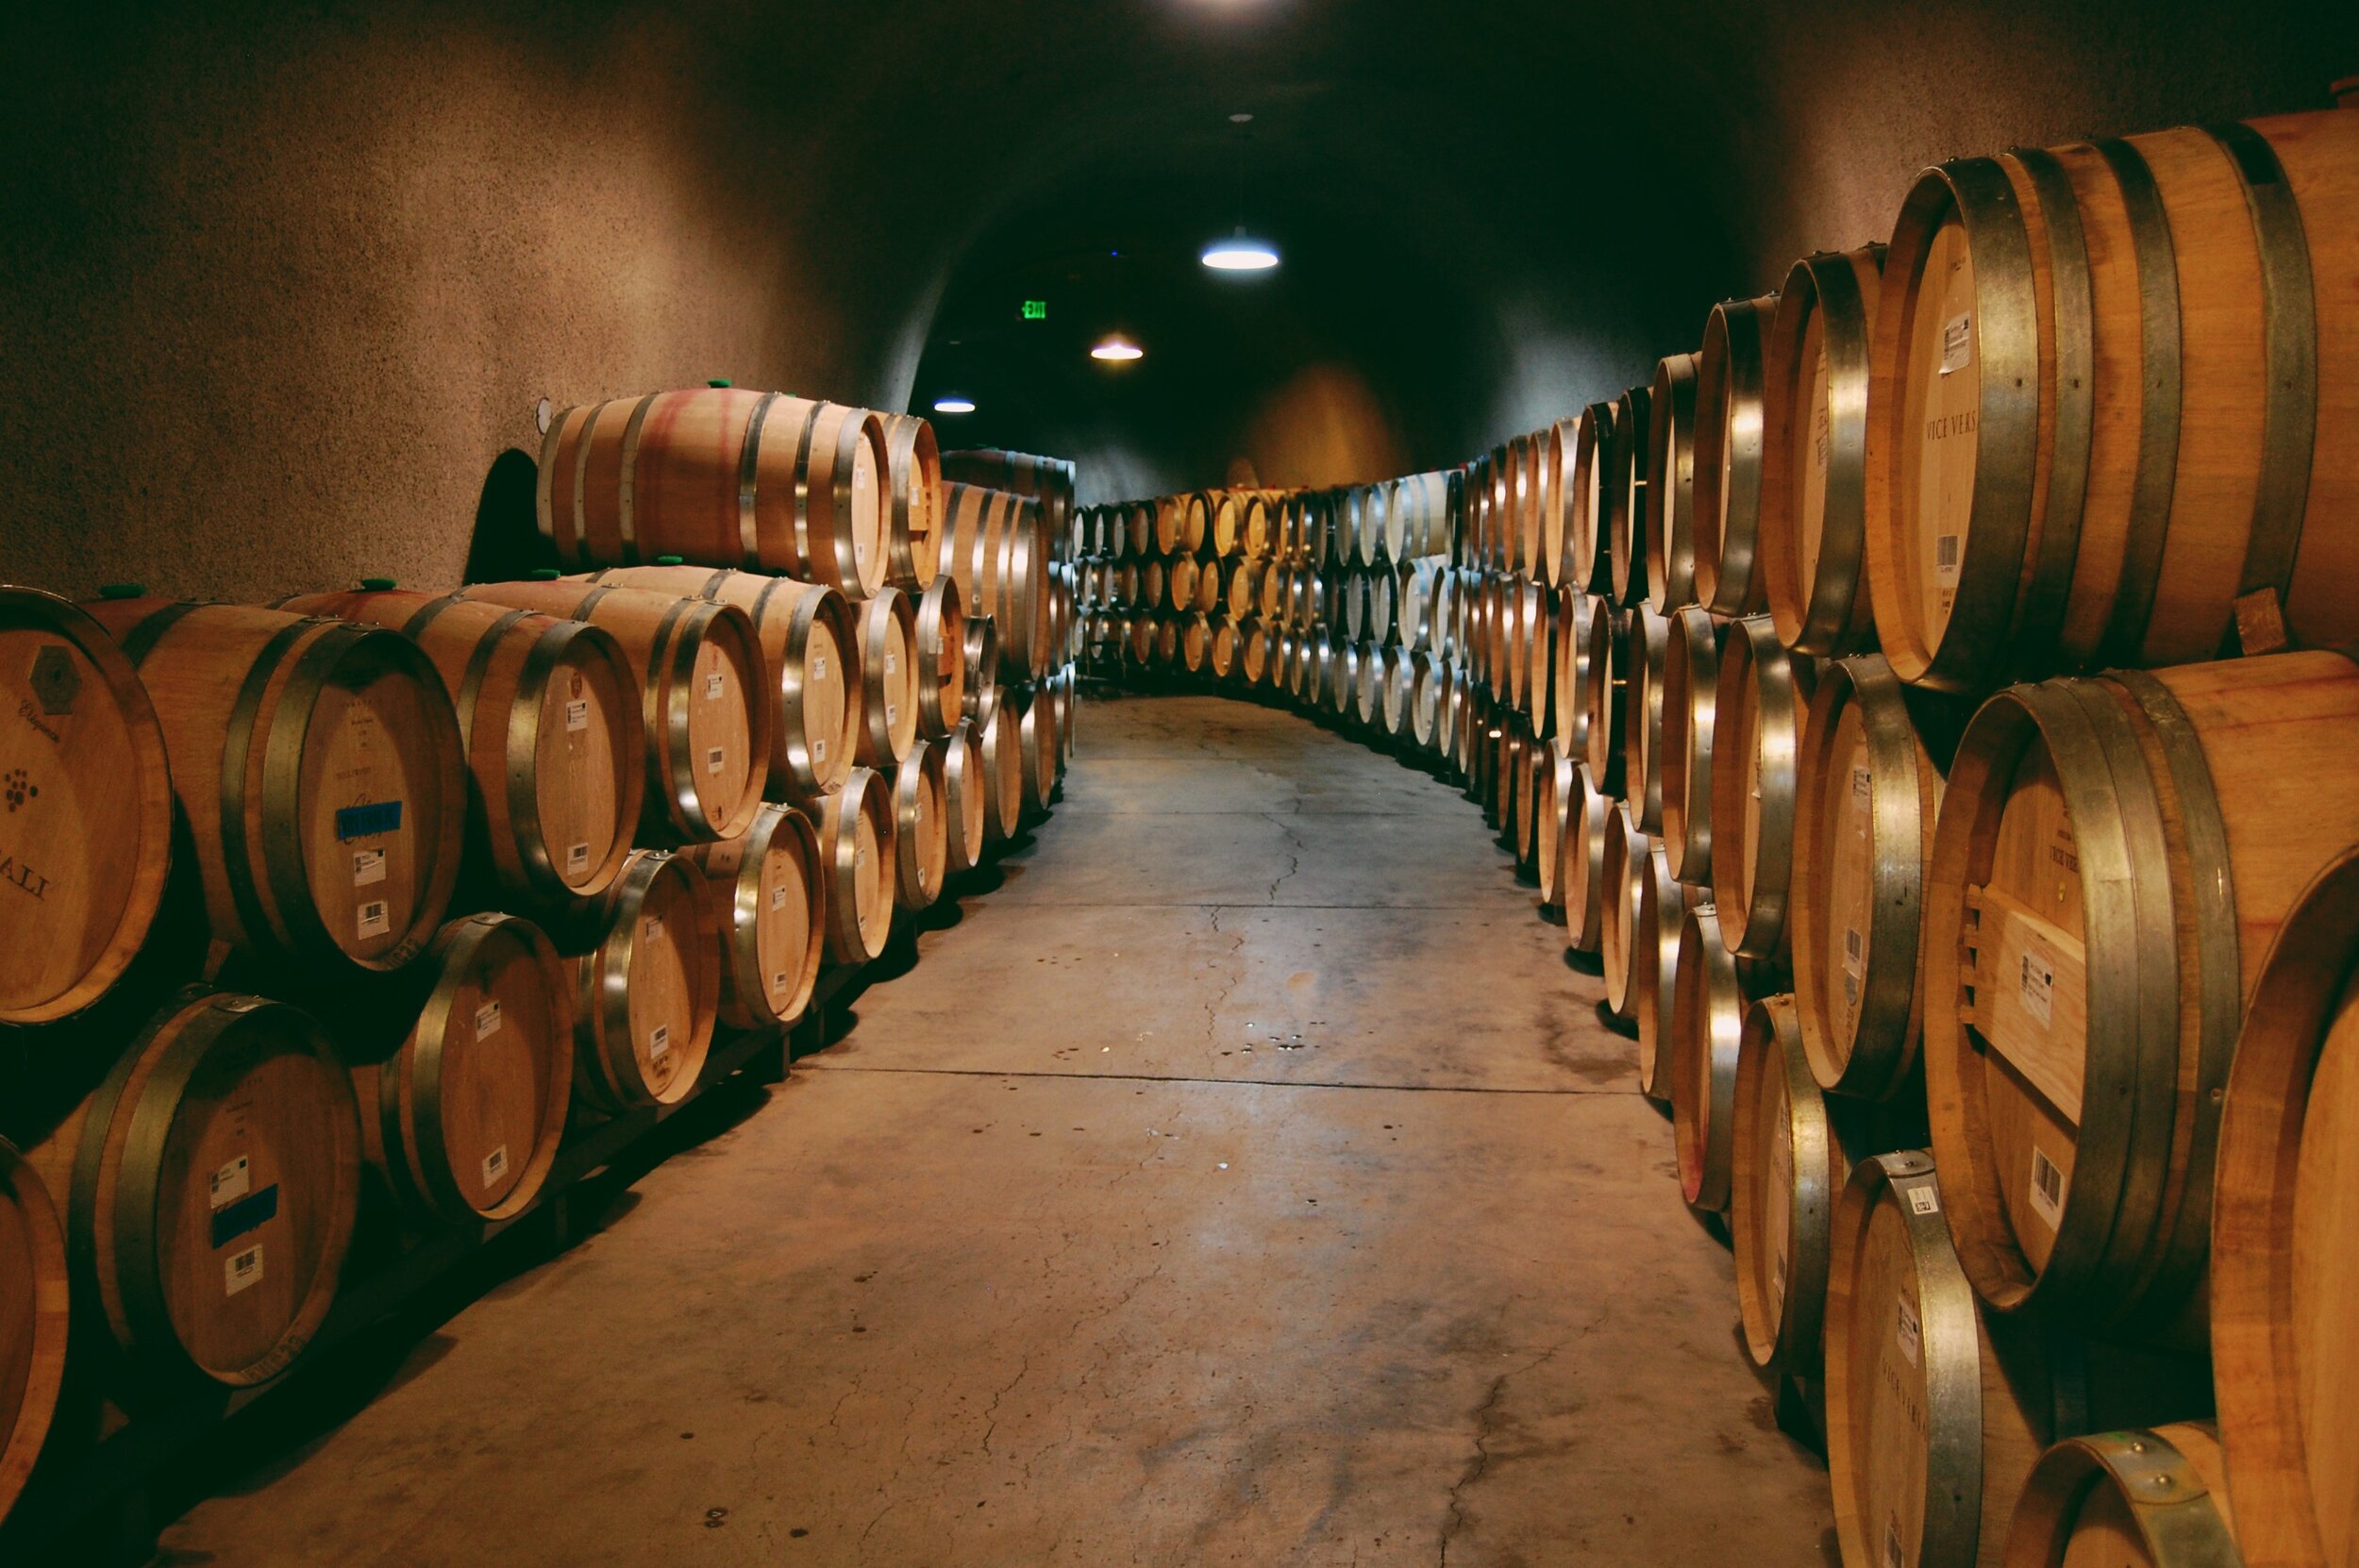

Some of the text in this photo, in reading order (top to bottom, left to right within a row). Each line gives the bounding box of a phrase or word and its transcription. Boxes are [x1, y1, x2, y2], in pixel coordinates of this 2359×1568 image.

[1025, 301, 1046, 319] EXIT
[1926, 409, 1979, 441] VICE VERS
